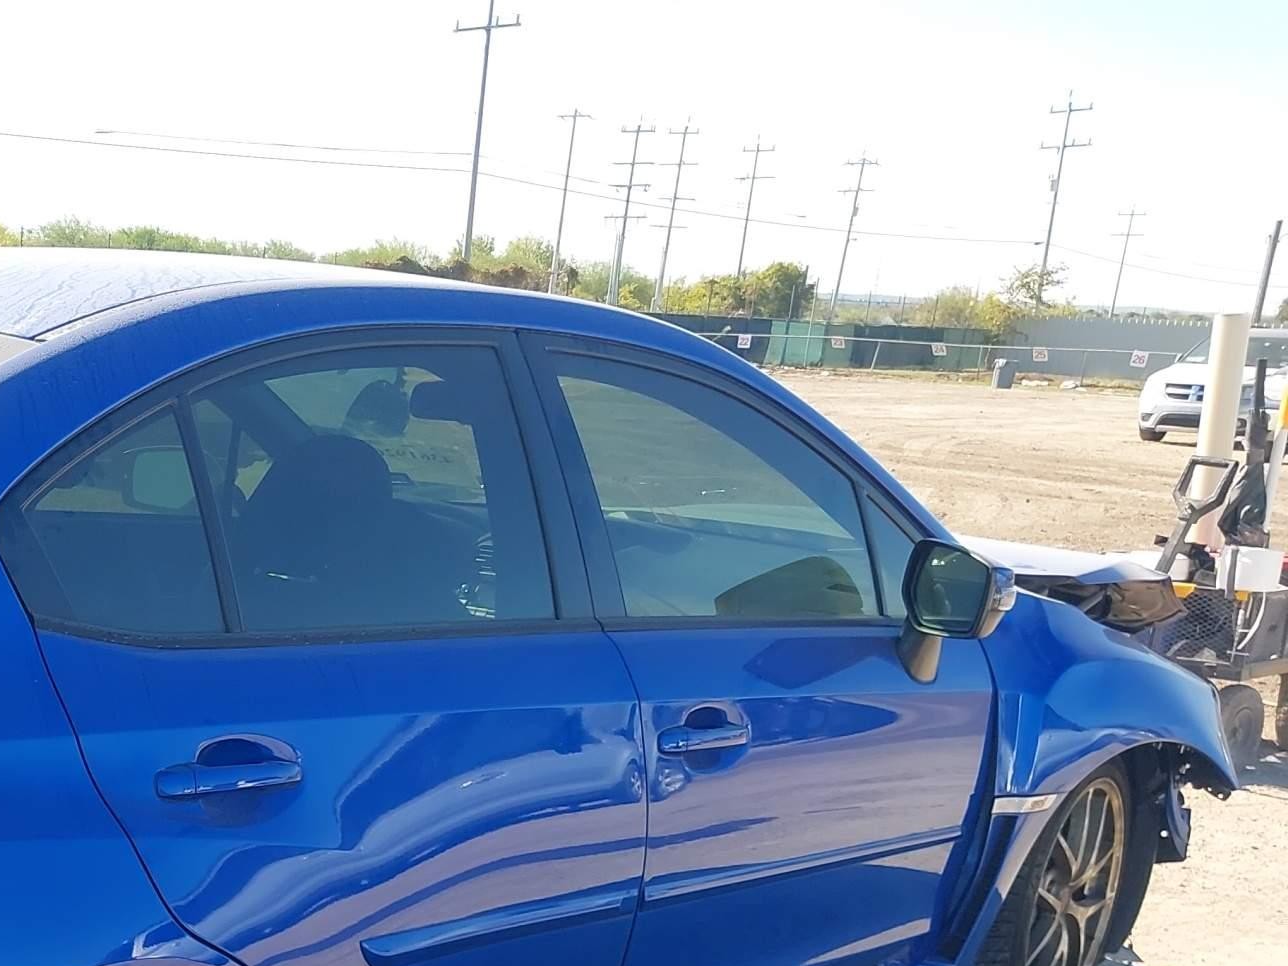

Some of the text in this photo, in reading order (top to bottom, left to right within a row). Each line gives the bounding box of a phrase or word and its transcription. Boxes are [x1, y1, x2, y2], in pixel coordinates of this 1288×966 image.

[739, 336, 750, 346] 22
[933, 344, 945, 353] 24
[1034, 350, 1047, 360] 25
[1132, 354, 1145, 365] 26
